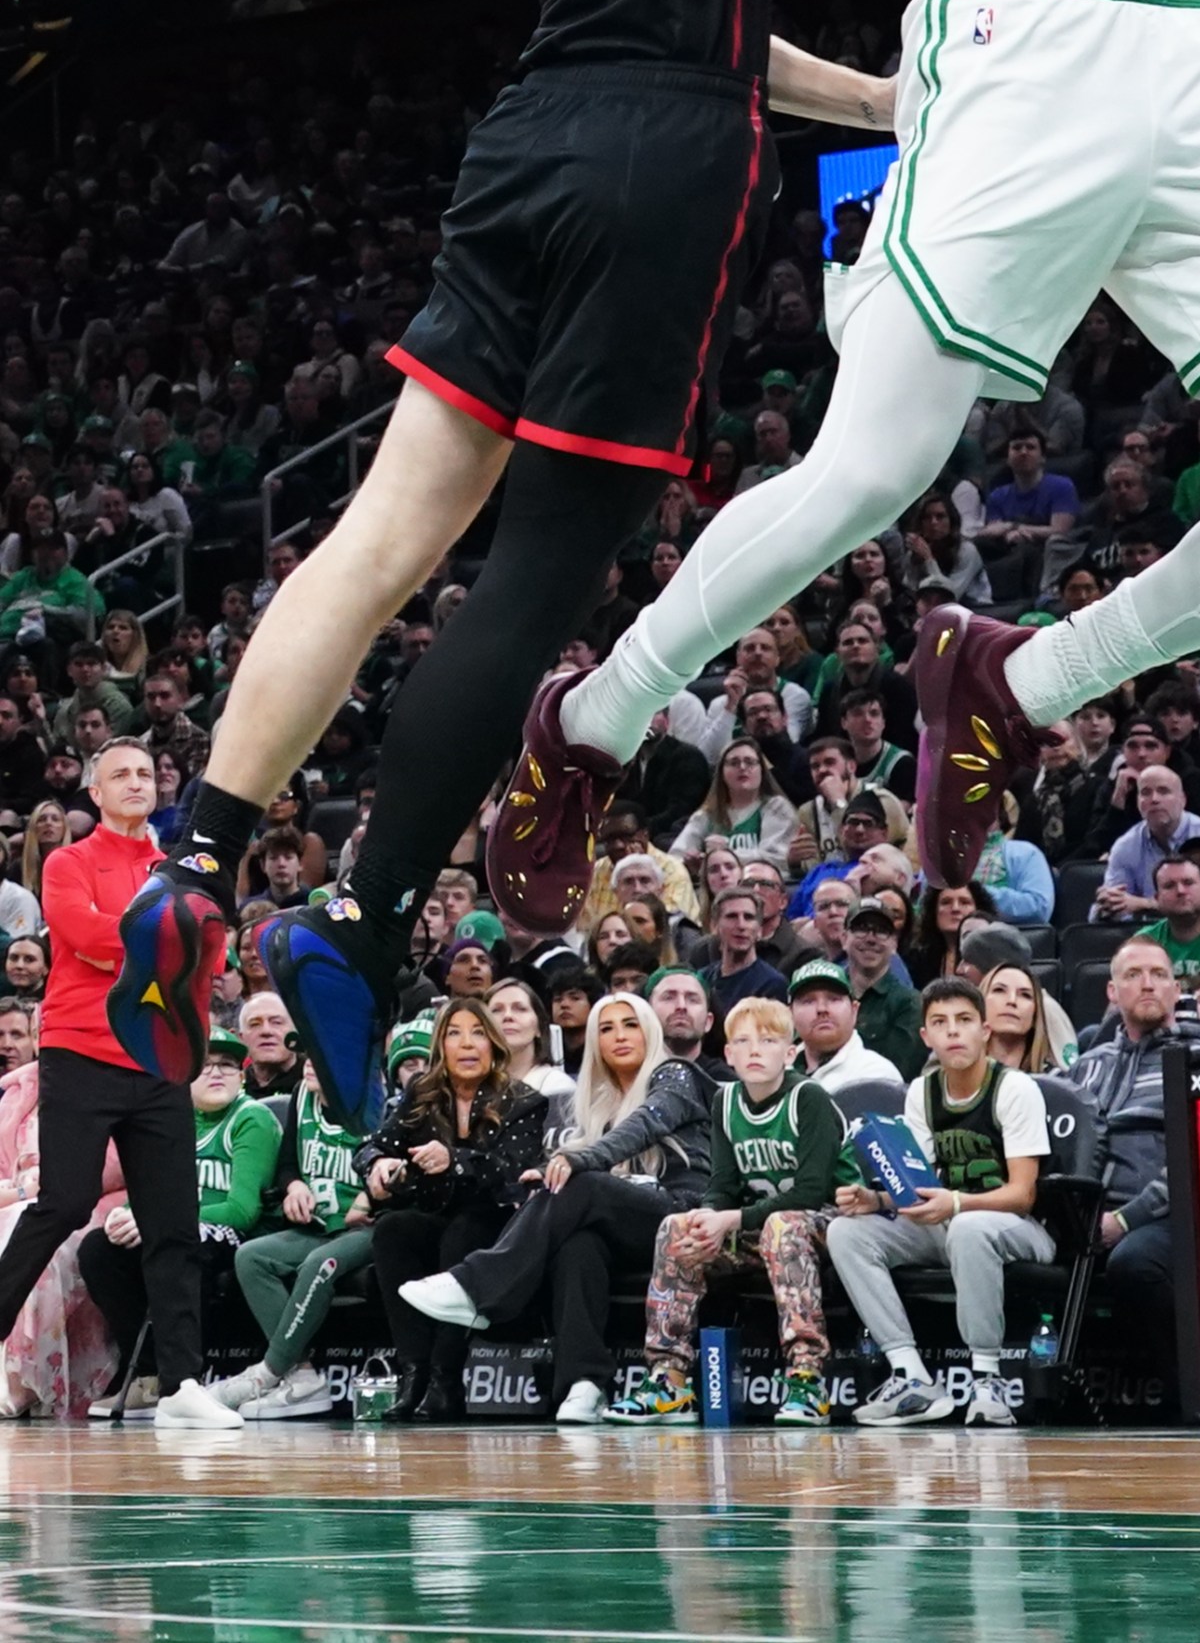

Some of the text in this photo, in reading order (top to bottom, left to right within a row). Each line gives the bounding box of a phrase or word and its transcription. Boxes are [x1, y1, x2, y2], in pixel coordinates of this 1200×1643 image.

[734, 1138, 799, 1174] CELTICS
[868, 1140, 905, 1195] POPCORN
[707, 1346, 721, 1410] POPCORN
